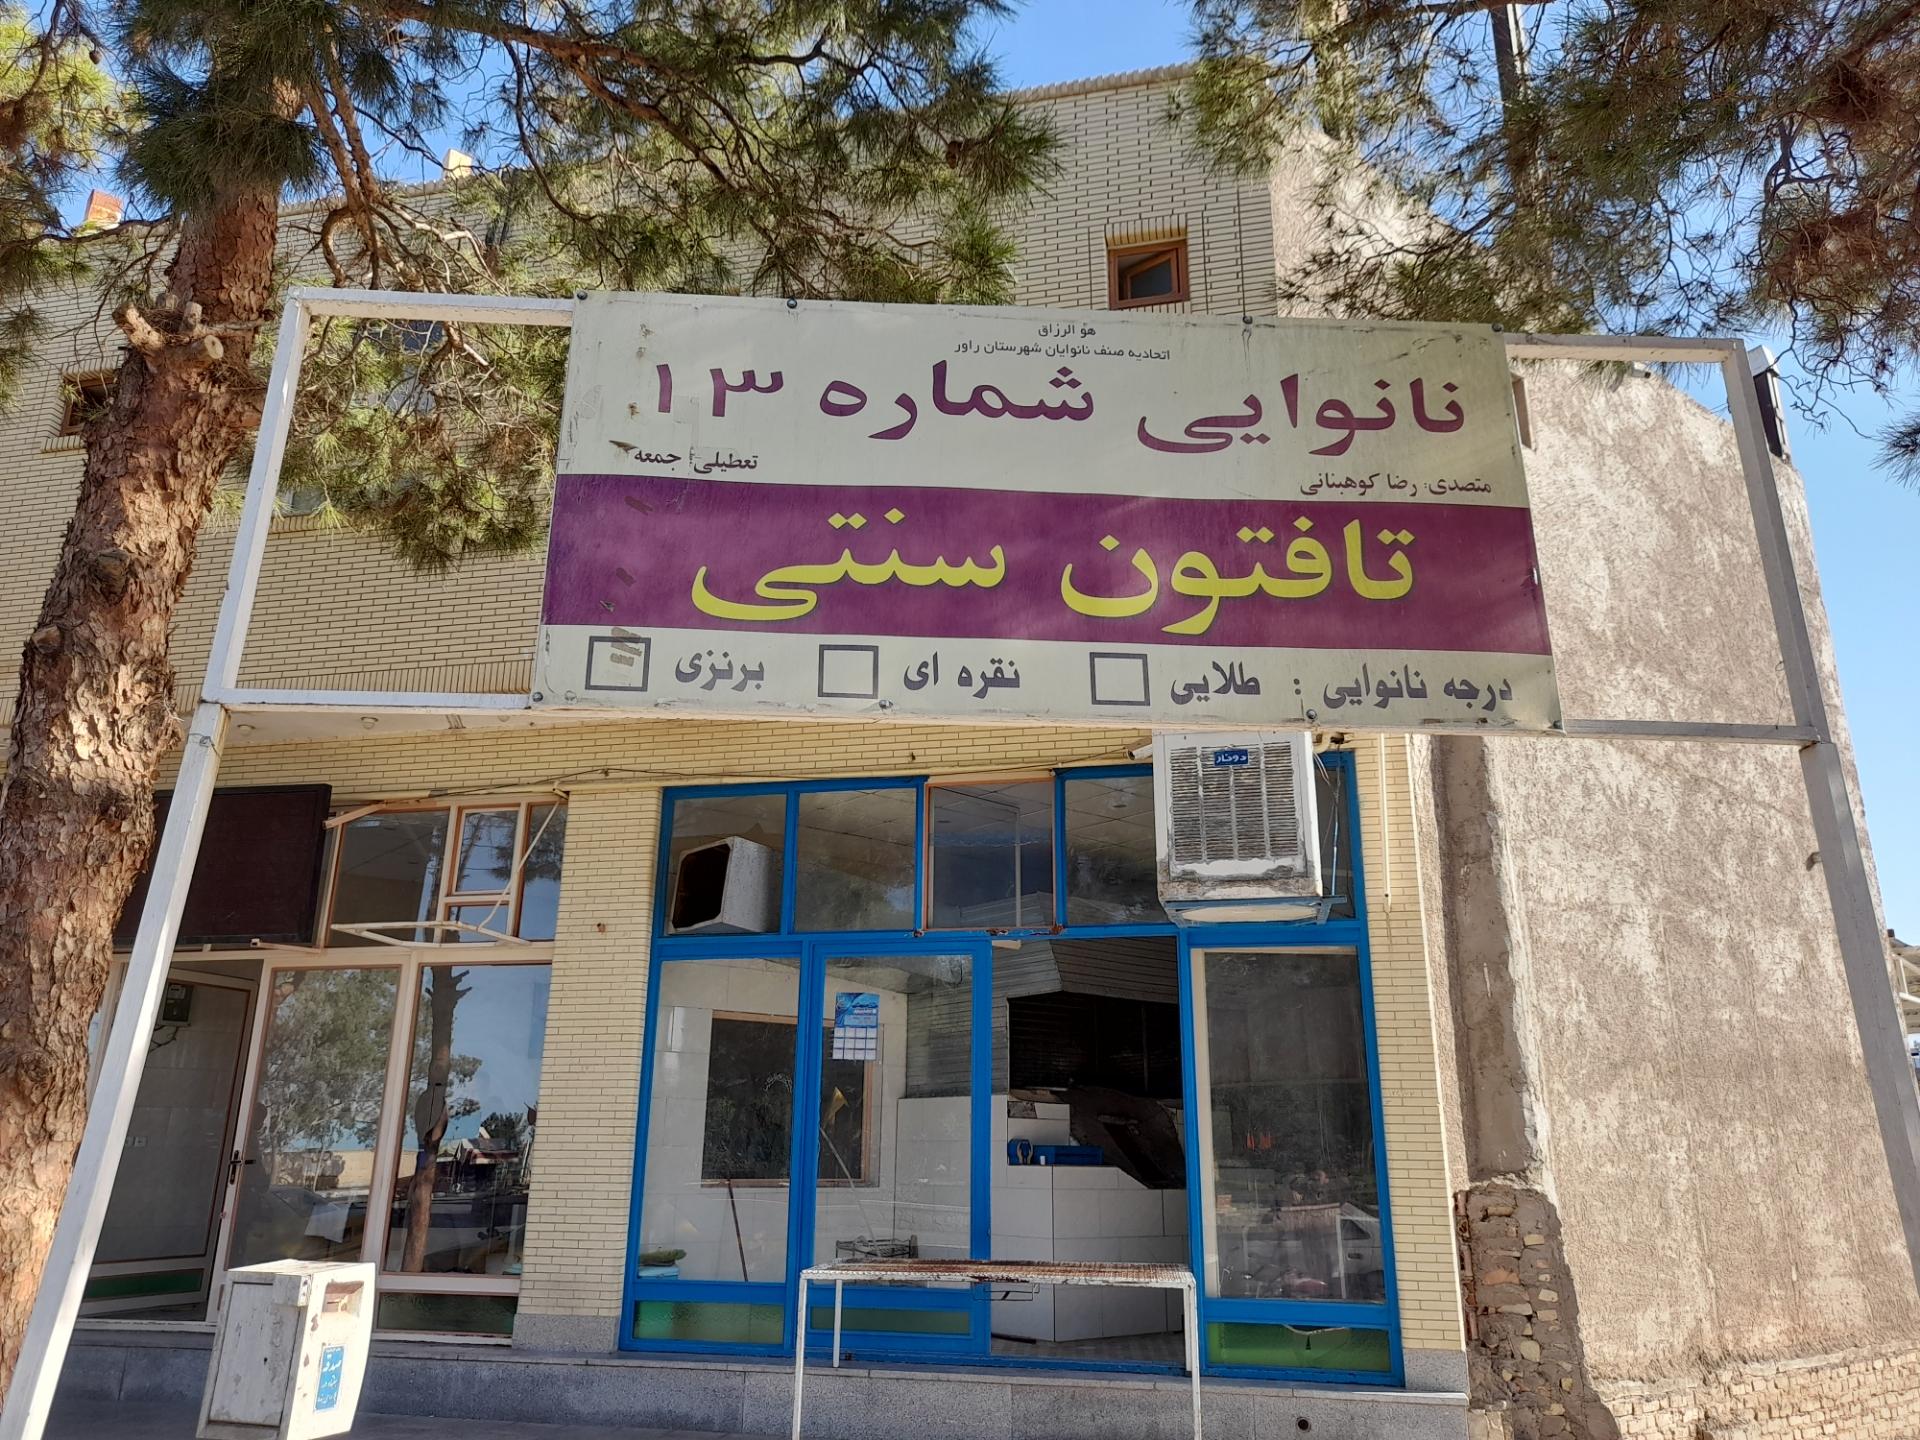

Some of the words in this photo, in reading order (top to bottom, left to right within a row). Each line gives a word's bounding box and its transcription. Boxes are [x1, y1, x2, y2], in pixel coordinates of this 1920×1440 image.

[1038, 323, 1075, 338] الرزاق
[954, 339, 980, 353] راور
[983, 341, 1042, 356] شهرستان
[1045, 343, 1090, 358] نانوایان
[1094, 345, 1125, 358] صنف
[1128, 348, 1171, 361] اتحادیه
[656, 362, 785, 418] ۱۳
[819, 359, 1095, 440] شماره
[1137, 372, 1465, 457] نانوایی
[634, 449, 682, 472] جمعه
[693, 451, 759, 475] تعطیلی
[1300, 472, 1381, 496] کوهبنانی
[1387, 473, 1418, 497] رضا
[1423, 478, 1492, 496] متصدی:
[690, 506, 1006, 621] سنتی
[1060, 515, 1416, 636] تافتون
[675, 649, 765, 692] برنزی
[903, 651, 940, 692] ای
[957, 657, 1021, 699] نقره
[1171, 660, 1262, 705] طلایی
[1324, 663, 1428, 710] نانوایی
[1443, 676, 1513, 711] درجه
